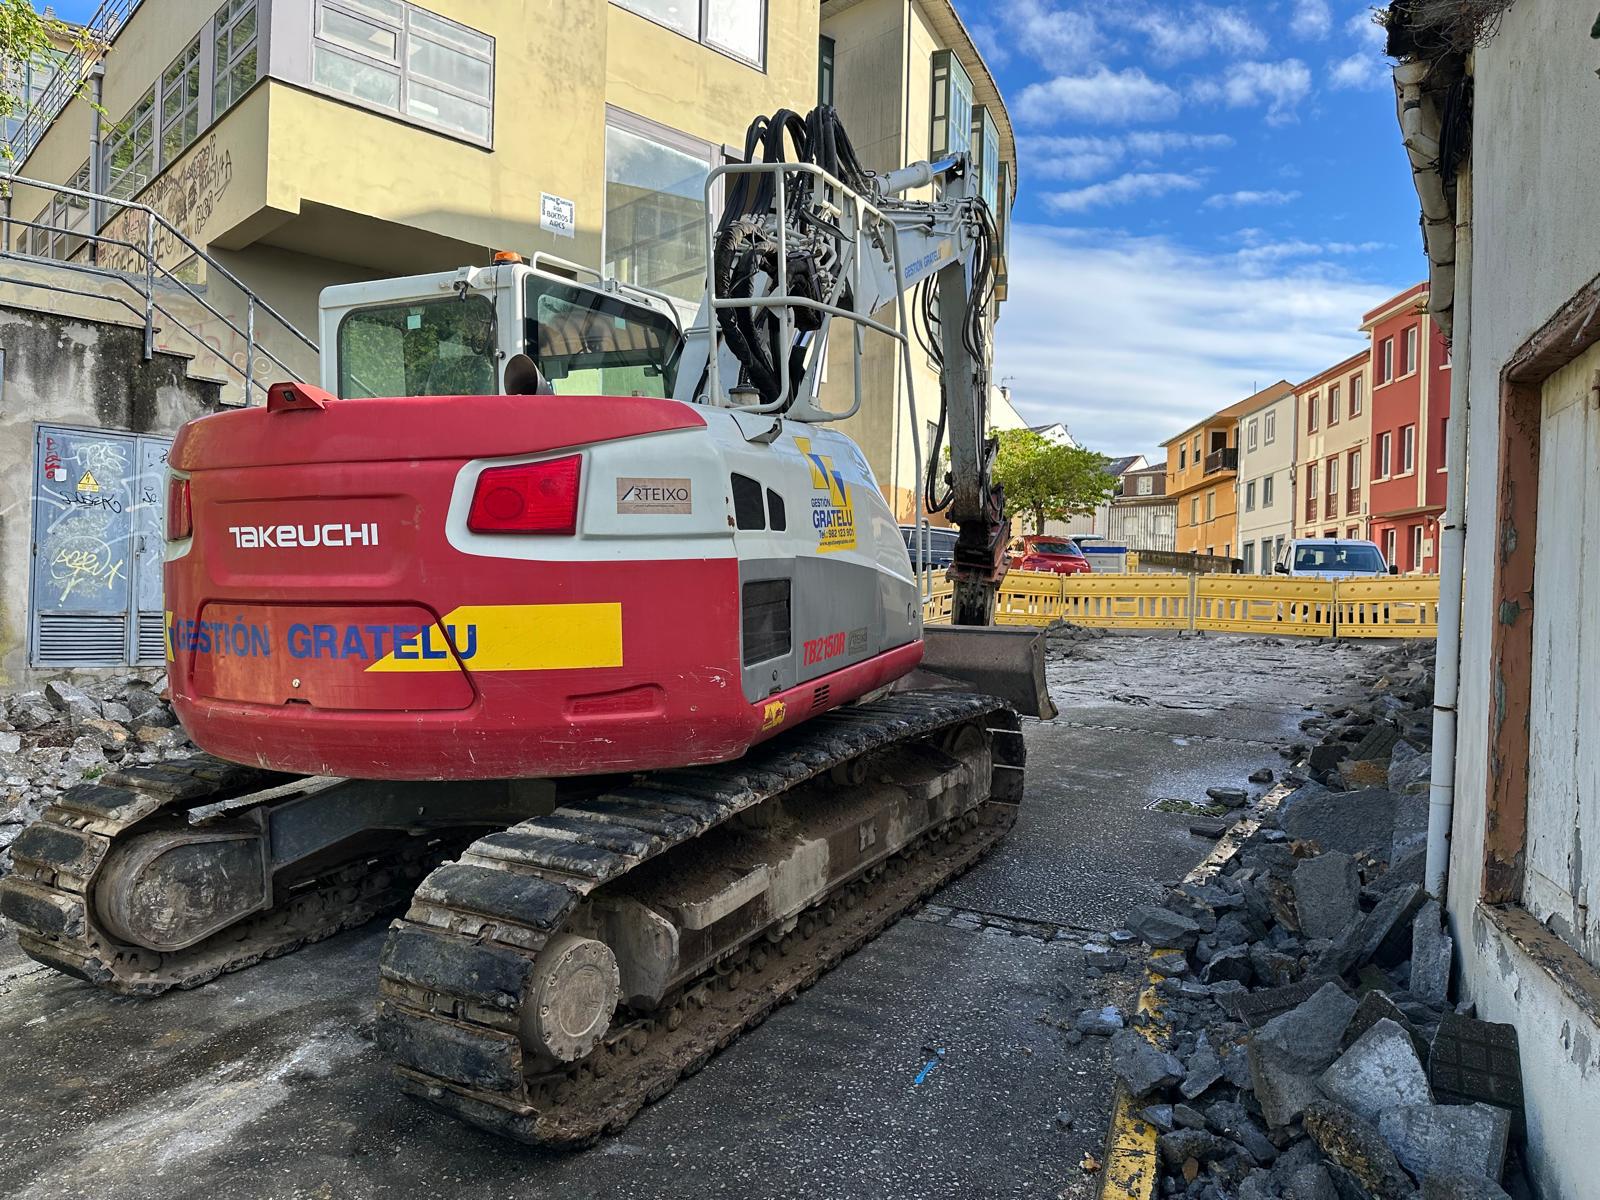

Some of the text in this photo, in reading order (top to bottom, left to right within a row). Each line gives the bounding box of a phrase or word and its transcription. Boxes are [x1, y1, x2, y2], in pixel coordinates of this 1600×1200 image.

[811, 497, 831, 508] GESTIÓN
[812, 509, 853, 529] GRATELU
[229, 523, 379, 548] TAKEUCHI
[176, 612, 477, 660] GESTIÓN GRATELU
